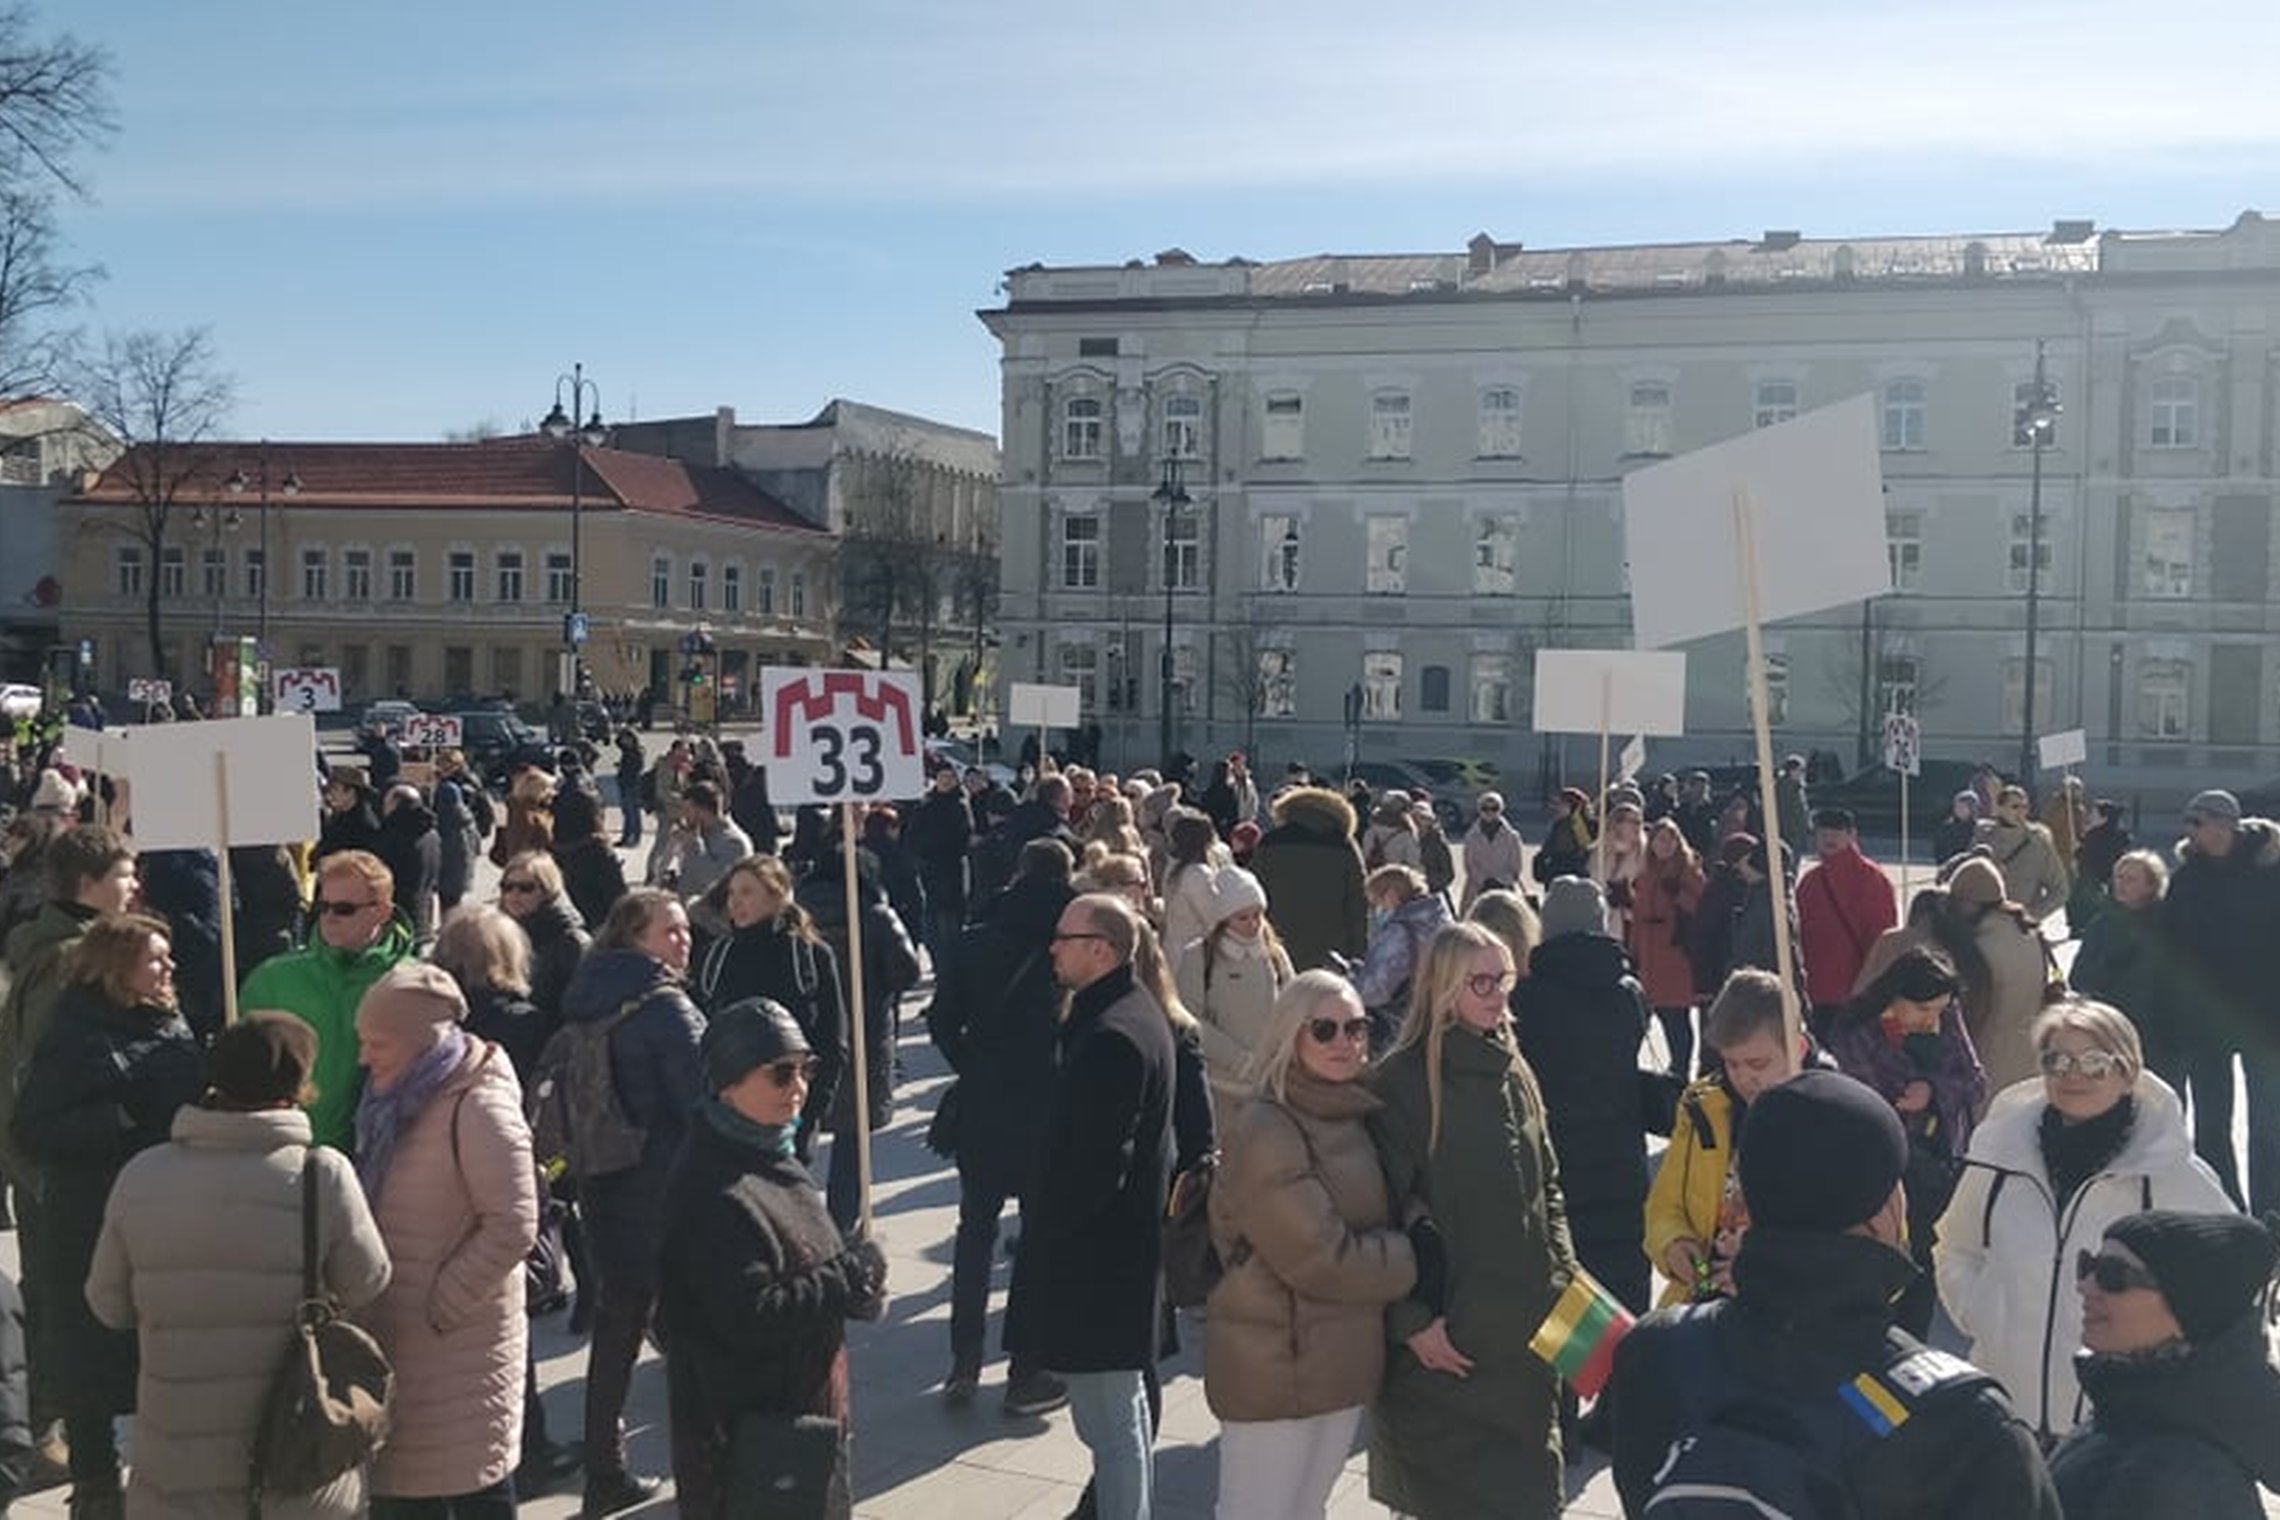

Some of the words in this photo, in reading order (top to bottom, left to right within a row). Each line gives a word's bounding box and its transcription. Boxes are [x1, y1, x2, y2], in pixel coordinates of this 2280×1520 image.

[300, 686, 316, 709] 3
[421, 728, 447, 744] 28
[810, 725, 884, 796] 33
